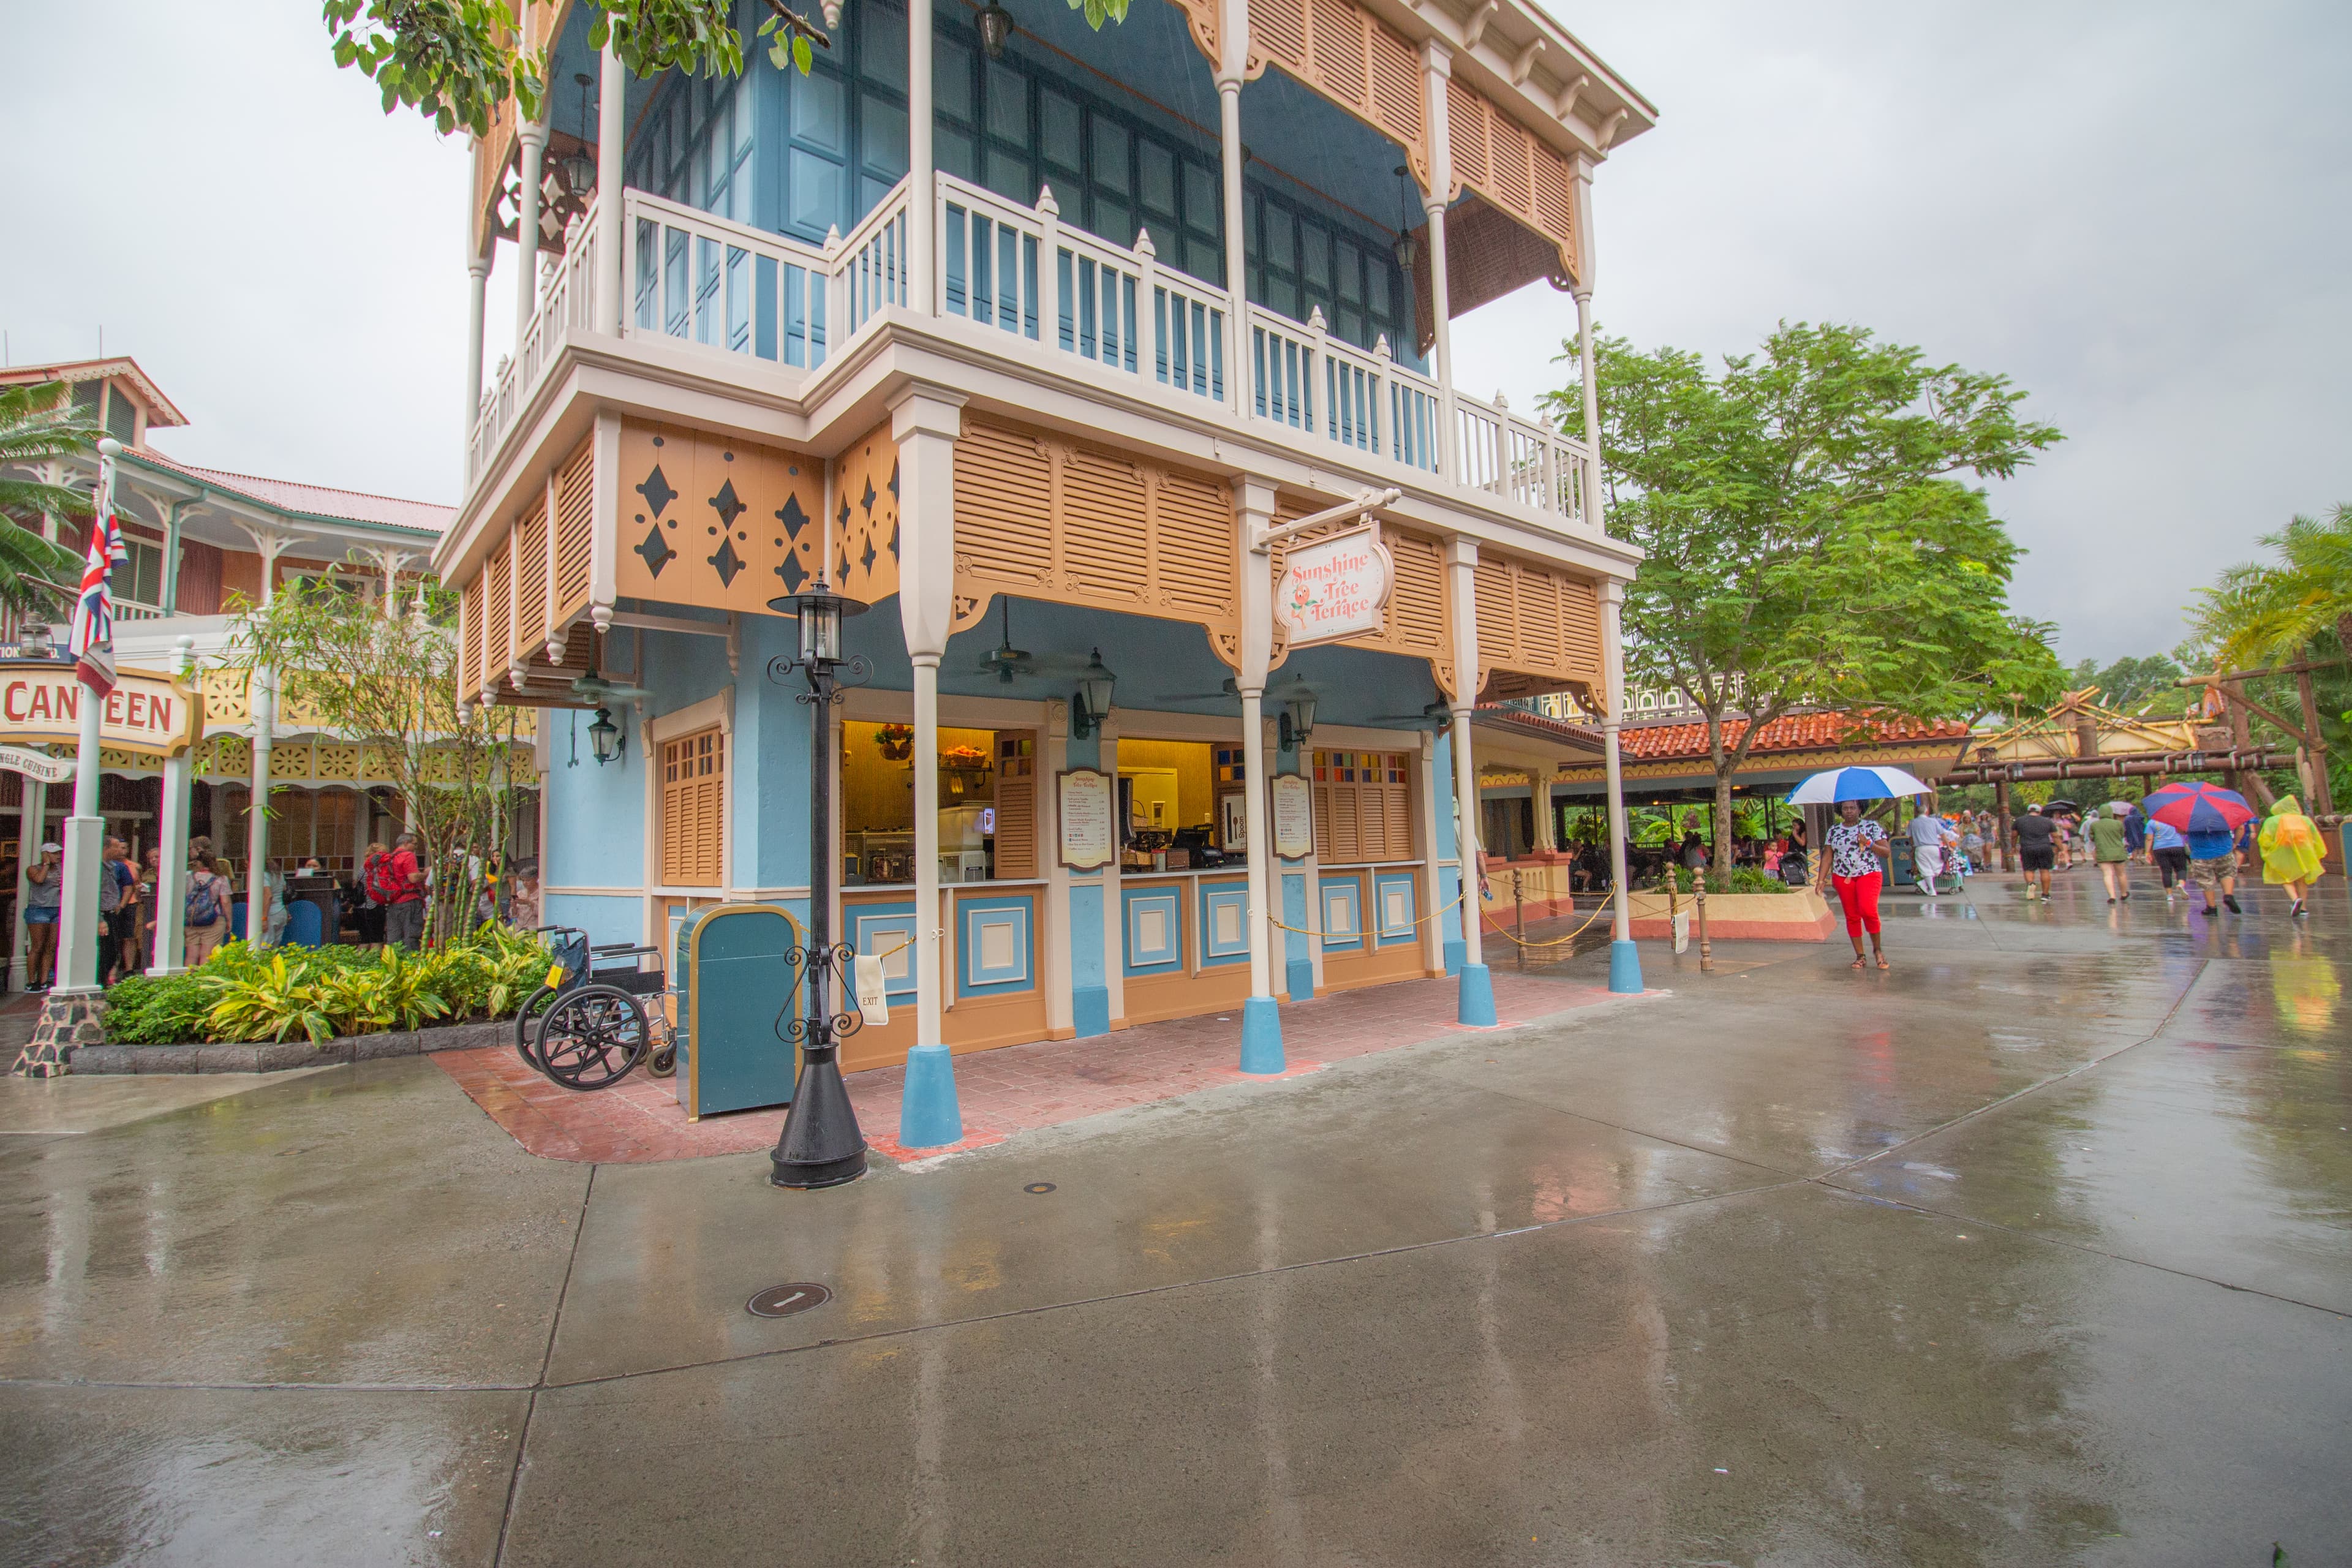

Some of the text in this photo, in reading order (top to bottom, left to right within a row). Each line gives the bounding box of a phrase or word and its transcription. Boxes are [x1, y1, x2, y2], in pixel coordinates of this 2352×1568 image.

[1292, 553, 1368, 586] Sunshine
[1323, 577, 1359, 601] Tree
[1311, 598, 1369, 622] Terrace
[0, 646, 20, 658] ION
[4, 681, 172, 733] CANEEN
[23, 758, 58, 778] CUISINE
[863, 997, 878, 1006] EXIT
